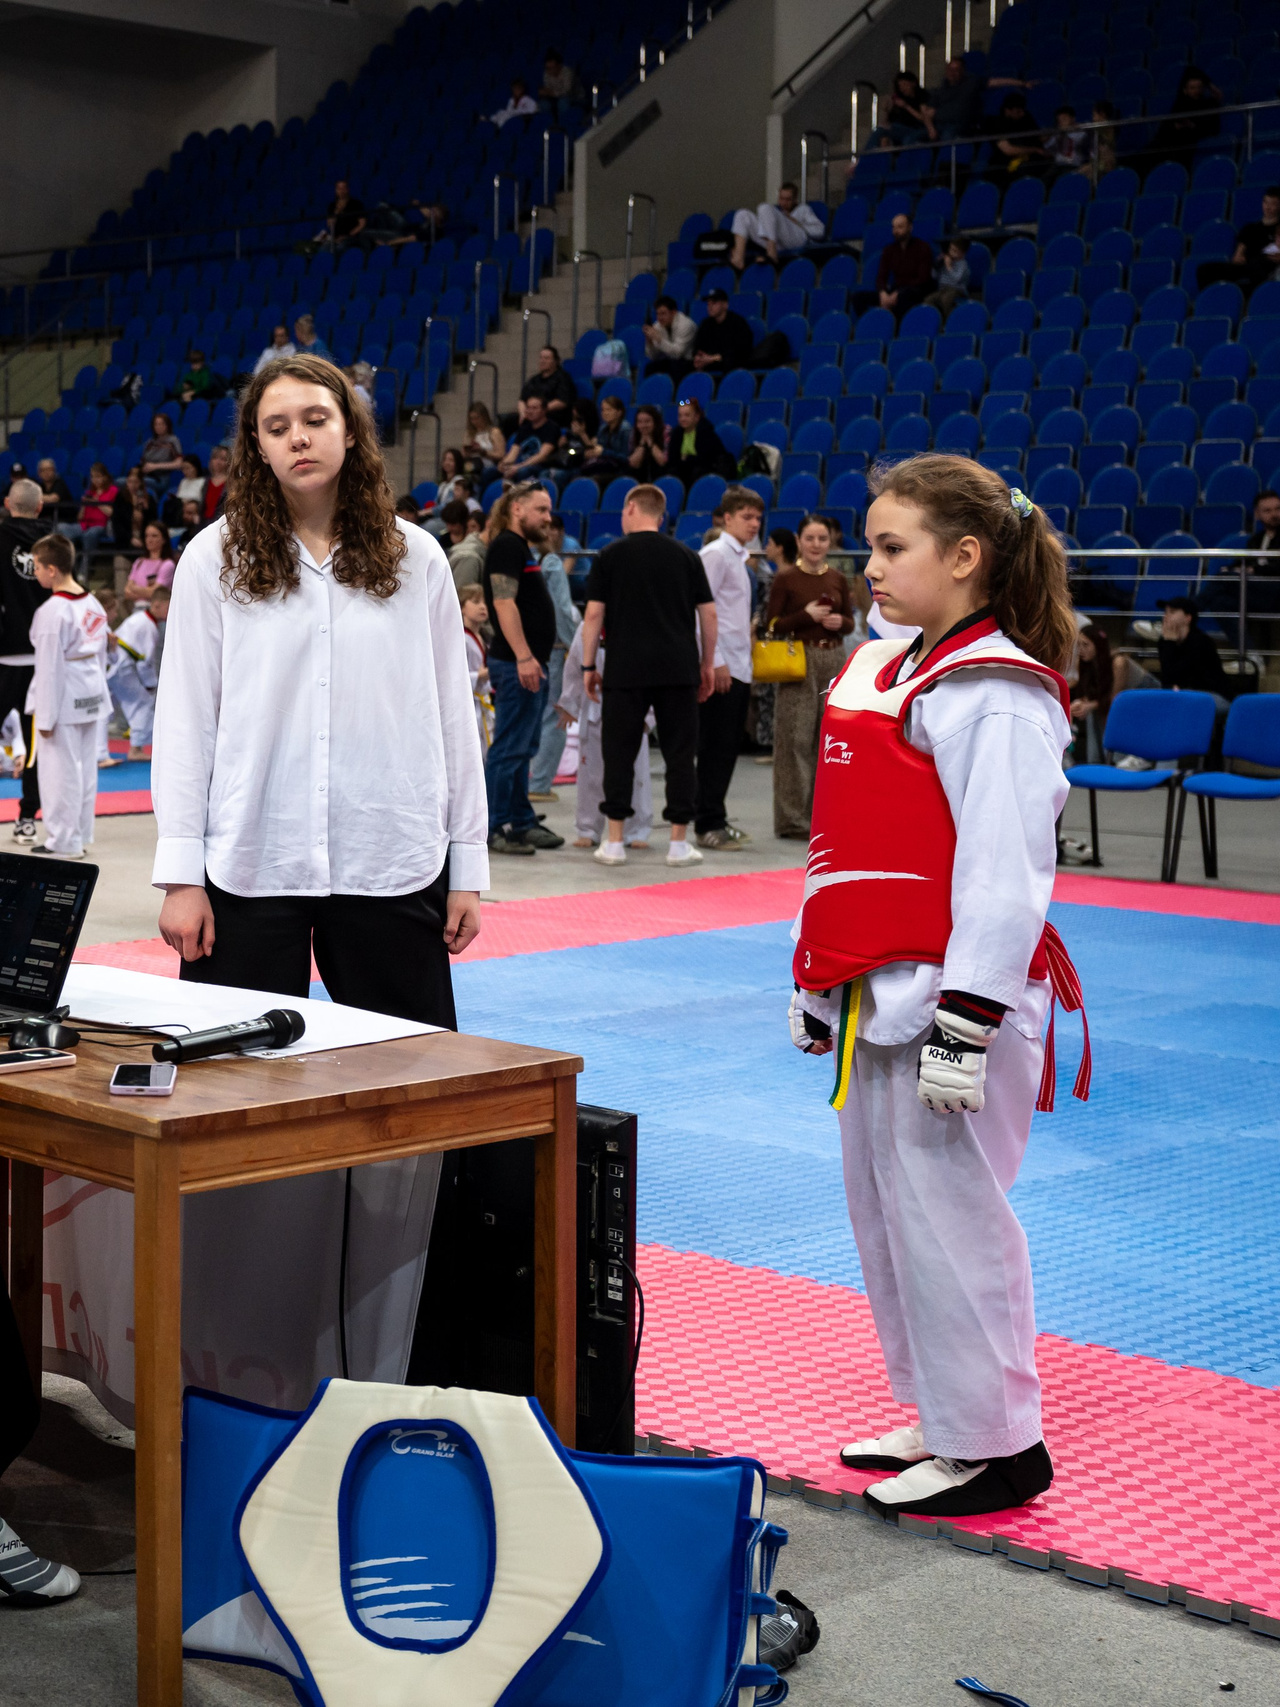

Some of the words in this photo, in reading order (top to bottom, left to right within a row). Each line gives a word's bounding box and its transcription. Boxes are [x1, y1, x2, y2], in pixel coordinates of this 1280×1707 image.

[841, 751, 853, 760] WT
[804, 950, 811, 969] 3
[928, 1047, 964, 1065] KHAN
[437, 1441, 459, 1453] WT
[411, 1448, 435, 1456] GRAND
[435, 1451, 455, 1459] SLAM
